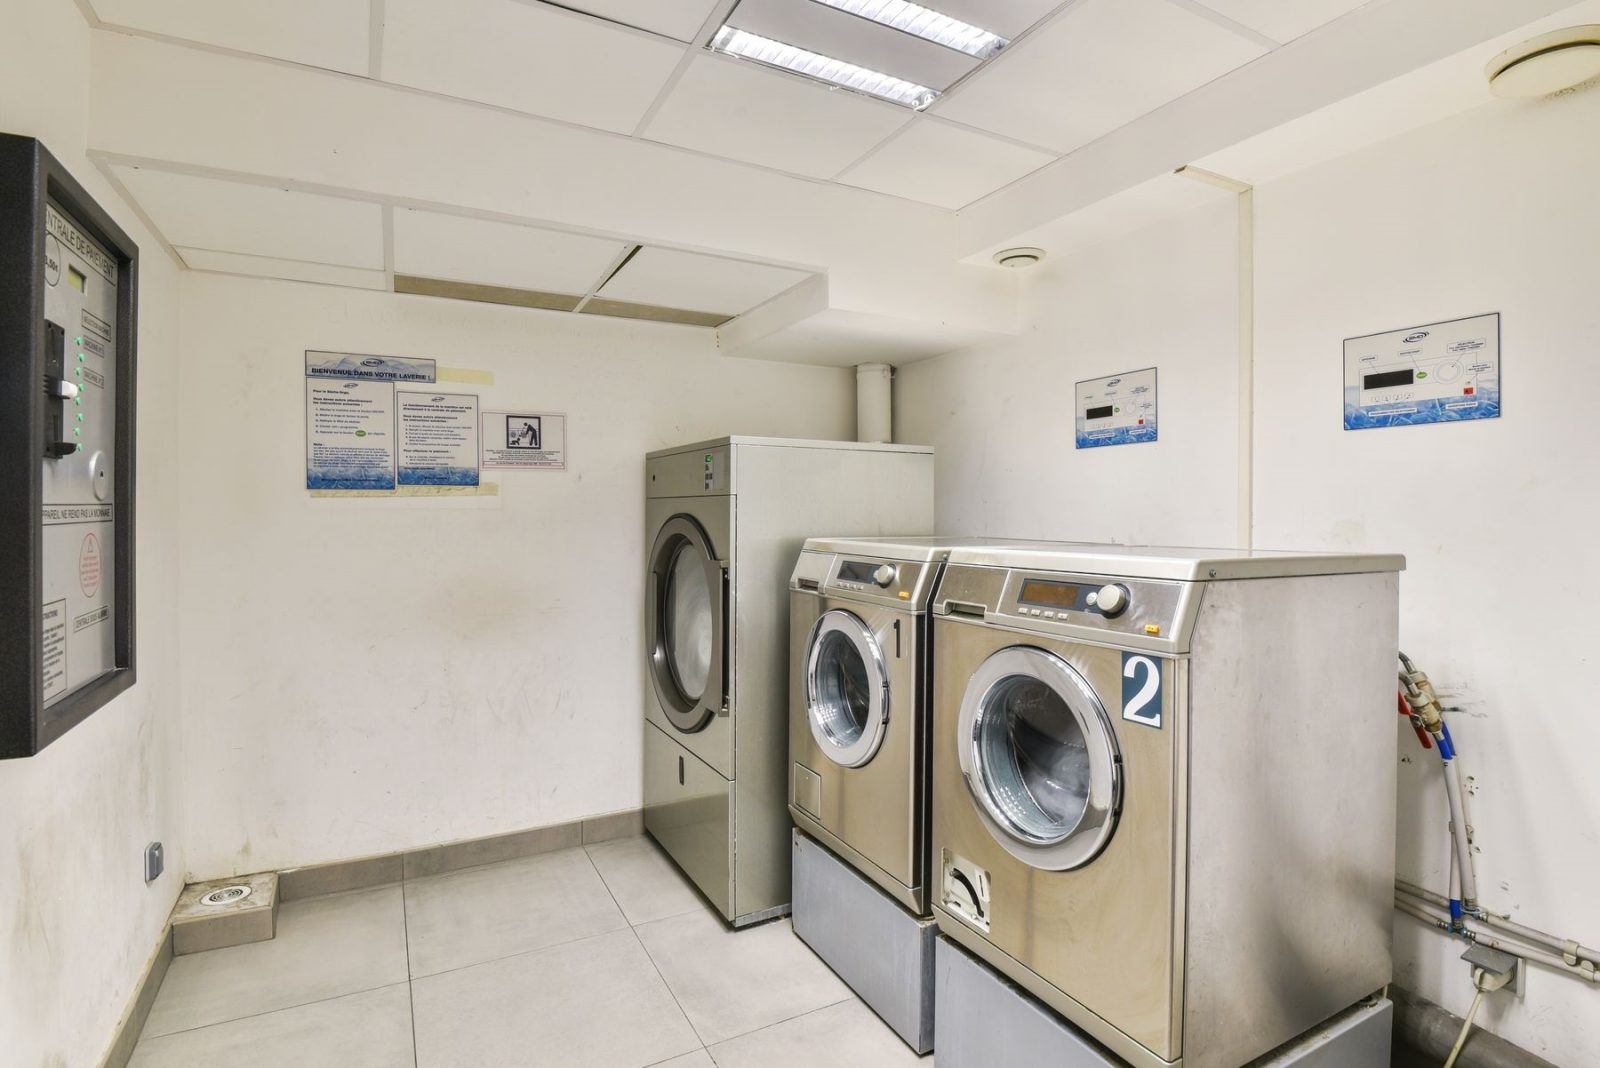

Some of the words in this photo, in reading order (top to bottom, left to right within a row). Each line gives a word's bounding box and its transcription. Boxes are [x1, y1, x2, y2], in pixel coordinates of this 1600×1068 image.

[76, 235, 85, 255] DE
[310, 367, 354, 378] BIENVENUE
[354, 370, 374, 378] DANS
[375, 371, 398, 380] VOTRE
[894, 618, 901, 658] 1
[1123, 655, 1161, 727] 2
